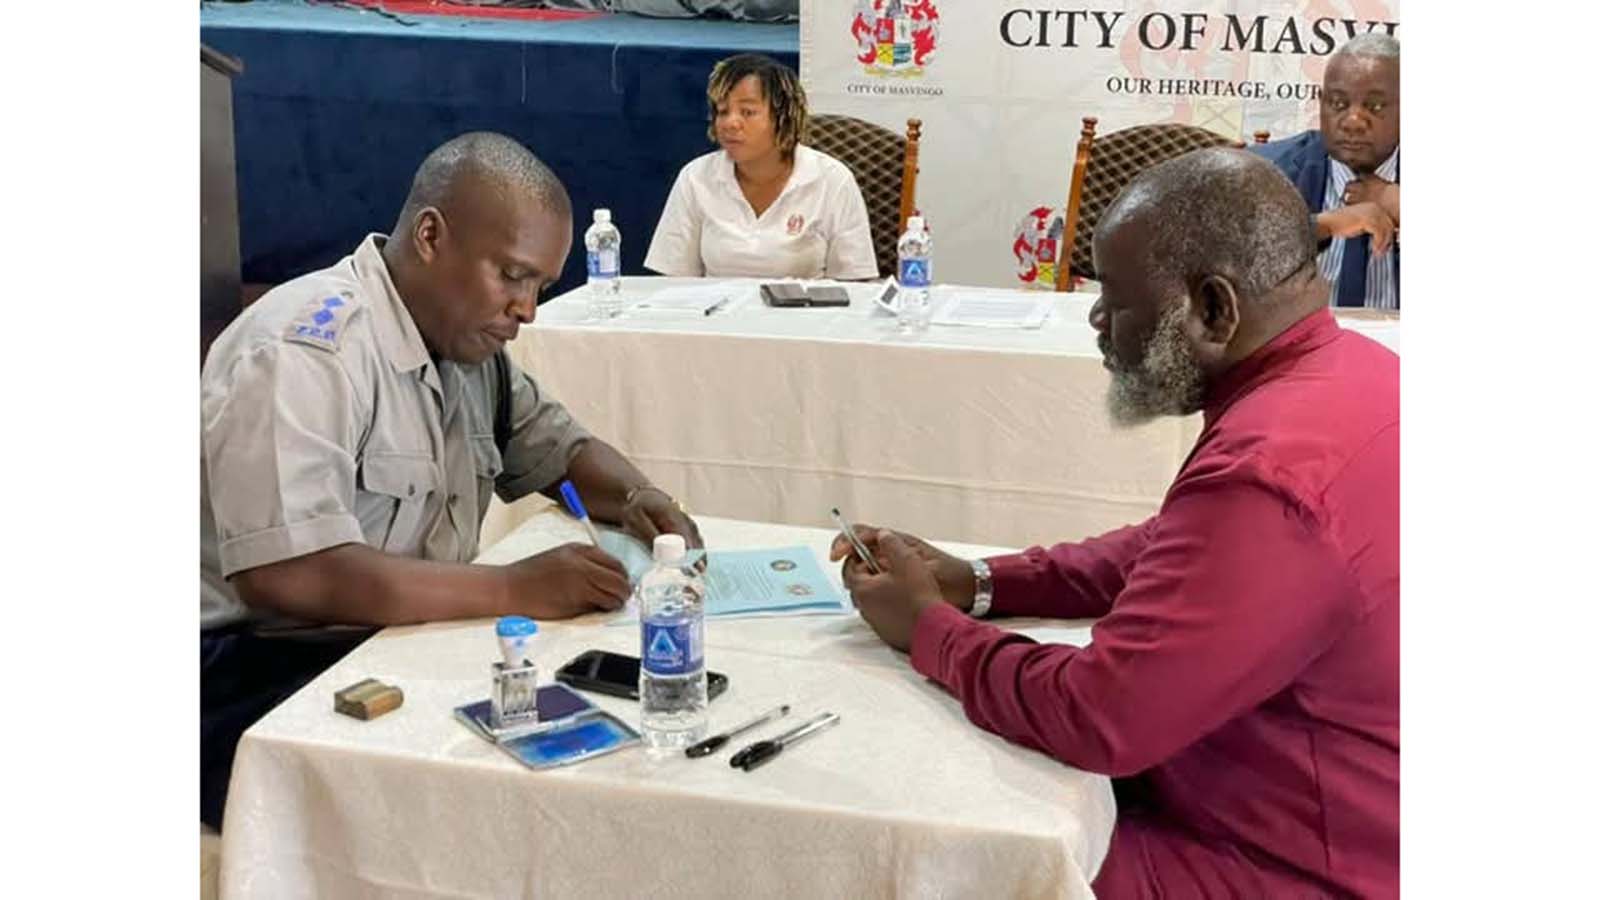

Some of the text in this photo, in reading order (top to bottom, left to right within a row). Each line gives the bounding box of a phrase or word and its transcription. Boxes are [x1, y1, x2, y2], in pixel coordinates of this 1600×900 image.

[1000, 9, 1125, 48] CITY
[1138, 12, 1208, 51] OF
[847, 84, 871, 94] CITY
[872, 85, 886, 95] OF
[1106, 76, 1152, 94] OUR
[1158, 78, 1271, 101] HERITAGE,
